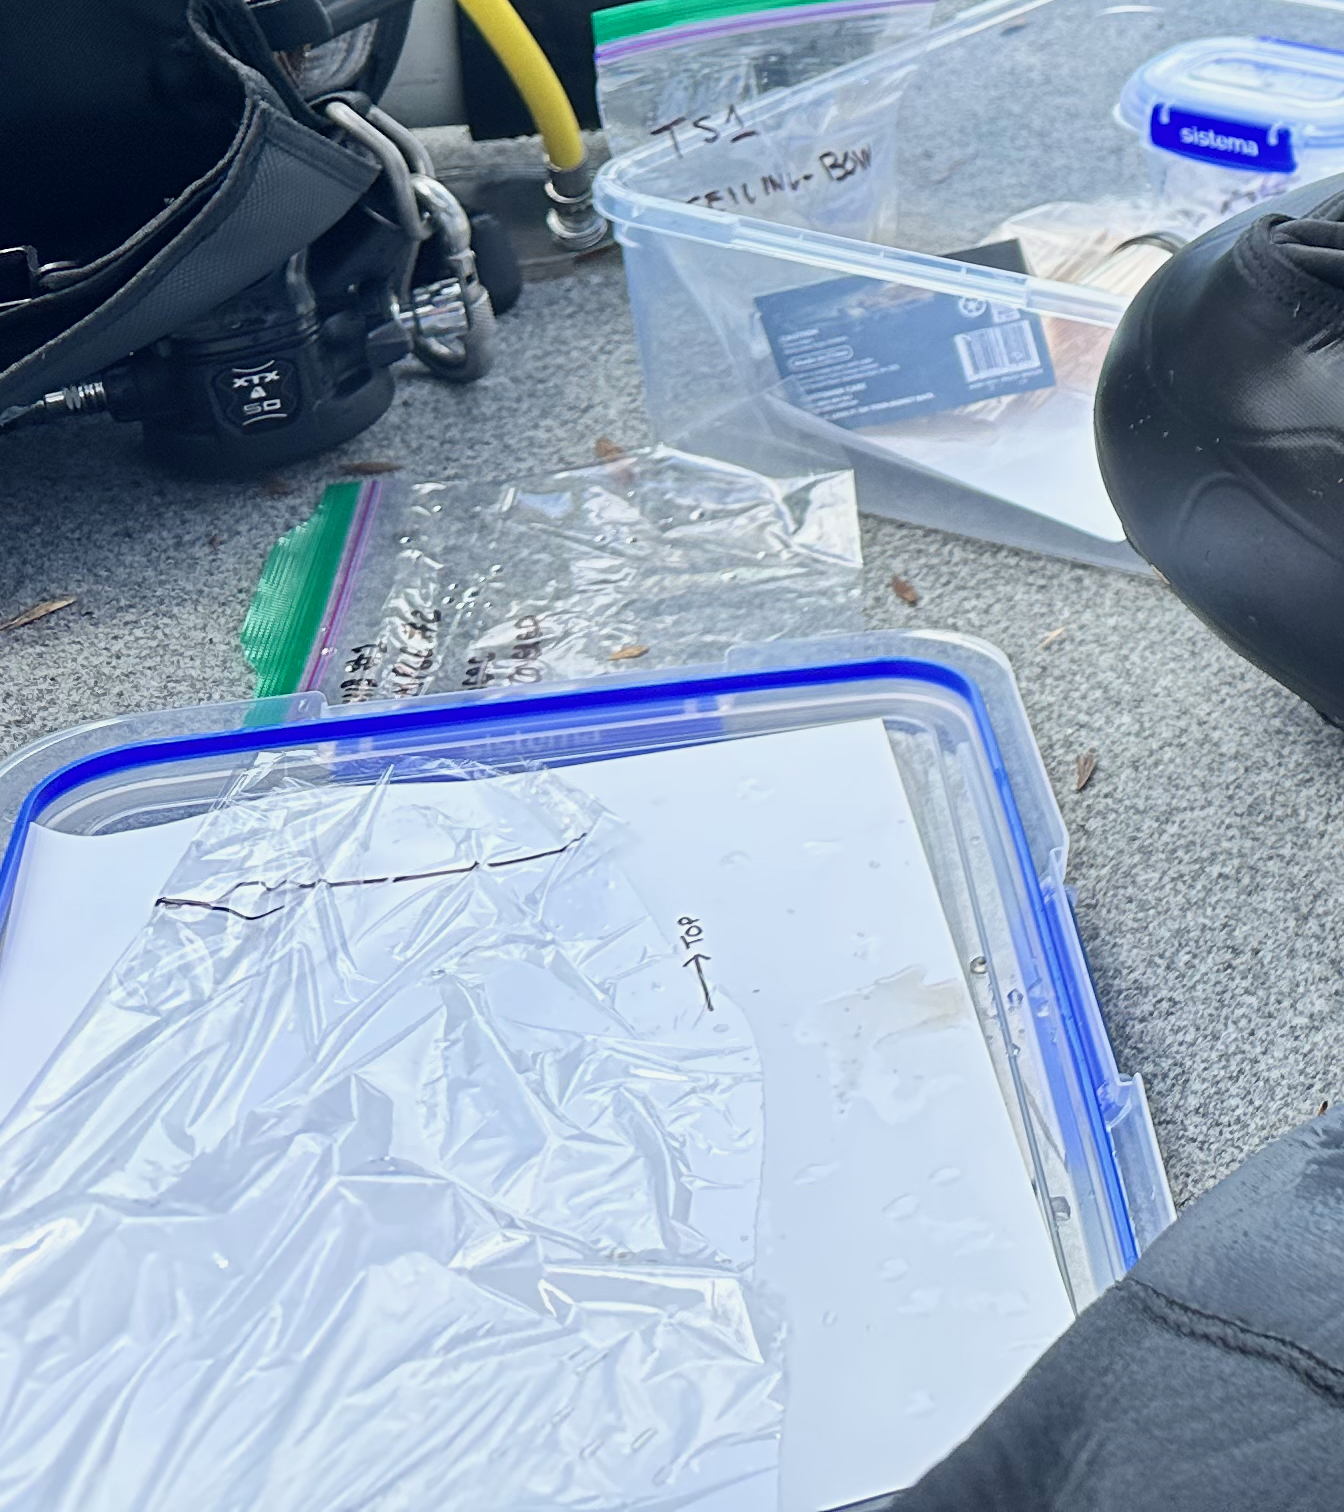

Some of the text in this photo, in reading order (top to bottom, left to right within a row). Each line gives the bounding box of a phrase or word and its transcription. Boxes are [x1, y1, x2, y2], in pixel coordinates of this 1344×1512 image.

[1179, 125, 1260, 158] sistema
[233, 370, 280, 388] XTX
[243, 398, 282, 416] 50
[677, 916, 704, 951] TOP
